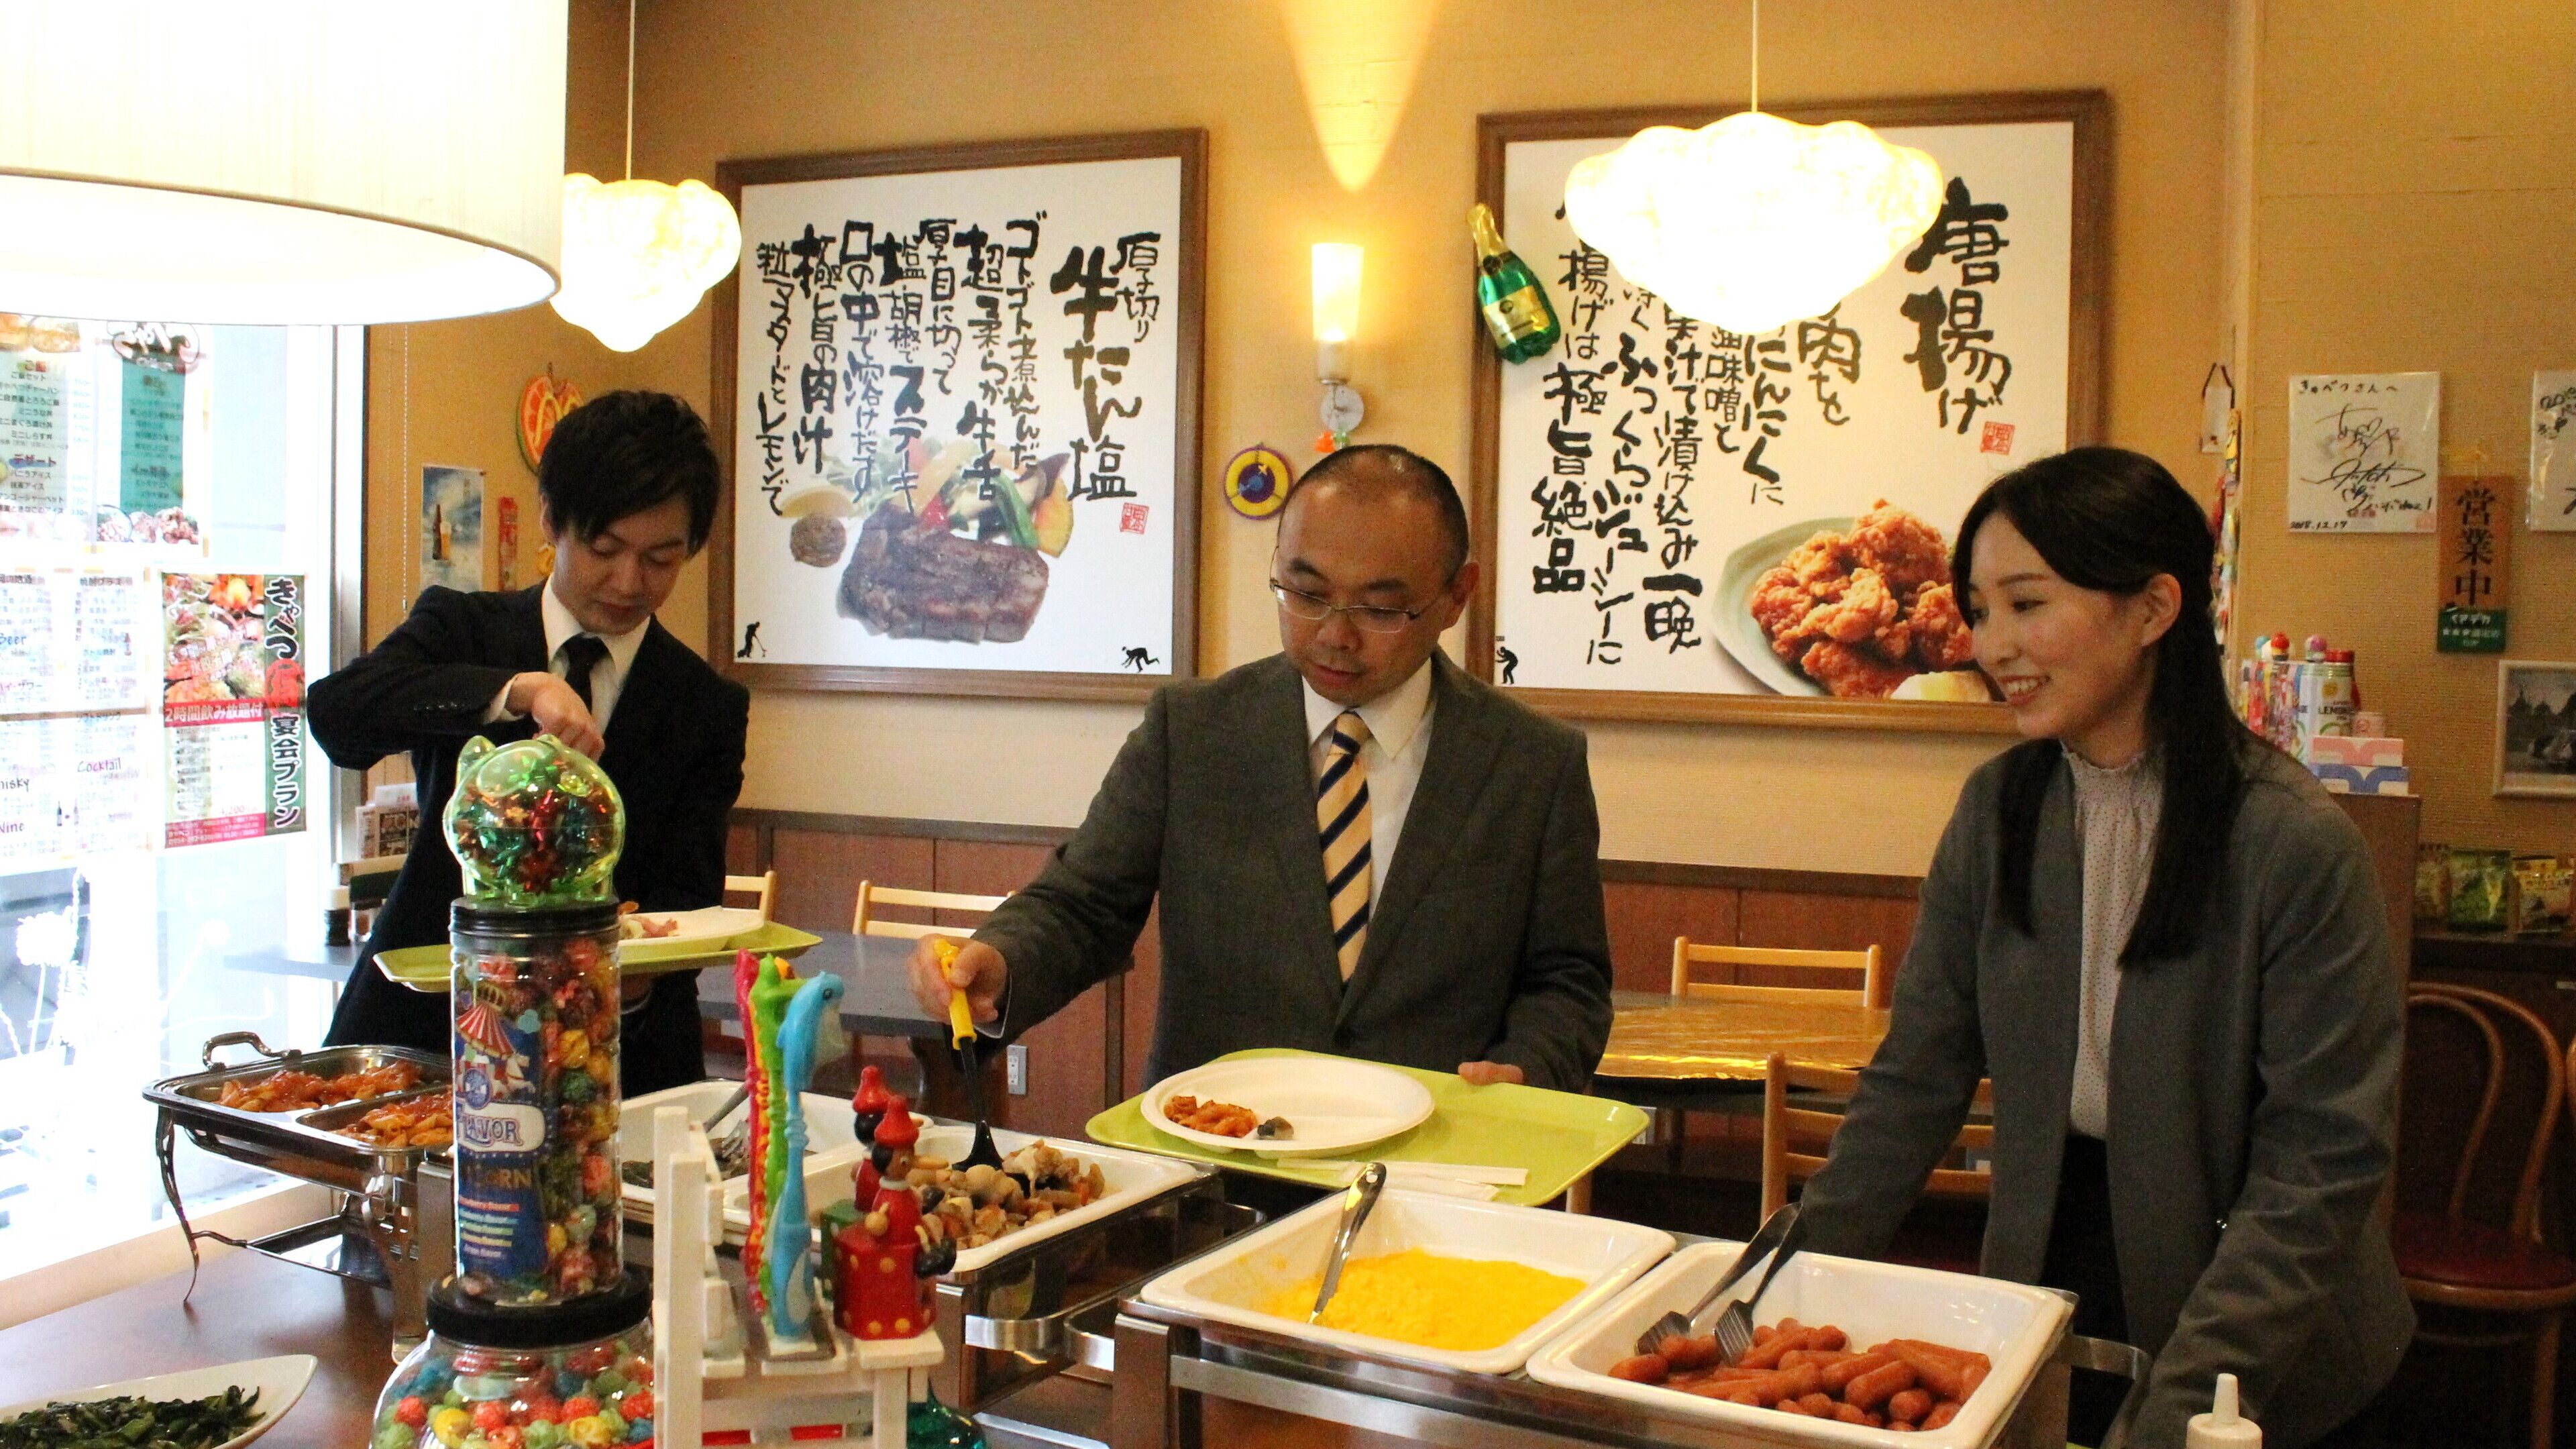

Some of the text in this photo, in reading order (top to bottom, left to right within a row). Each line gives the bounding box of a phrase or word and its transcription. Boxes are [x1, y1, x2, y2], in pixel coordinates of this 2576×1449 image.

[790, 223, 843, 474] 極旨の肉汁
[839, 219, 885, 504] 口の中で溶けだす
[912, 218, 962, 395] 厚目に切って
[953, 223, 1008, 501] 超柔らか牛舌
[1003, 209, 1047, 470] ゴトゴト煮込んだ
[1050, 246, 1142, 502] 牛たん塩
[1109, 231, 1161, 343] 厚切り
[1798, 303, 1862, 426] 肉を
[1900, 176, 2012, 435] 唐揚げ
[1532, 231, 1613, 594] 揚げは極旨絶品
[1586, 287, 1659, 665] くふっくらジューシーに
[1742, 326, 1792, 505] にんにくに
[264, 578, 301, 659] きゃべつ
[2456, 487, 2496, 605] 営業中
[77, 757, 121, 773] Cocktail
[165, 703, 264, 722] 2時間飲み放題付
[271, 715, 301, 828] 宴会プラン
